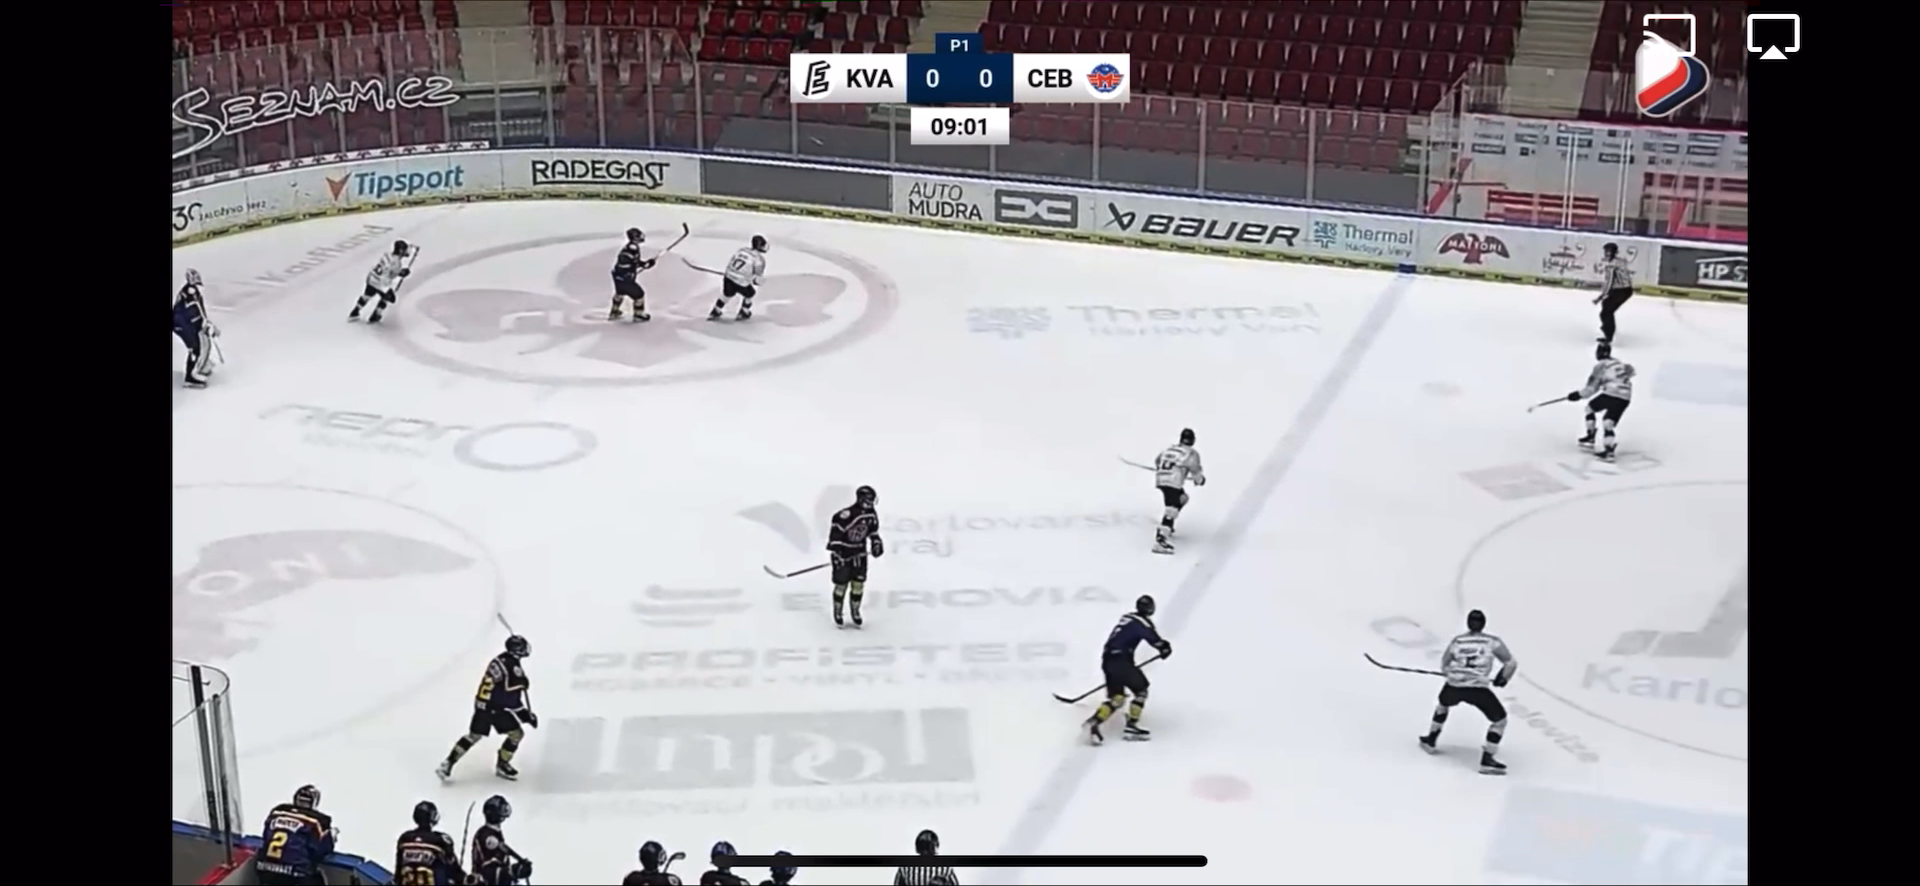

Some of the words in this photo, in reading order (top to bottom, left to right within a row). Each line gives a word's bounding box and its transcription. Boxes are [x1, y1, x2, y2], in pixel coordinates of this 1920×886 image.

[355, 165, 464, 198] Tipsport
[532, 159, 670, 189] RADEGAST
[909, 182, 963, 201] AUTO
[909, 199, 982, 221] MUDRA
[1343, 223, 1413, 244] Thermal
[1447, 239, 1503, 252] MATTONI
[1698, 263, 1729, 280] HP
[880, 510, 1163, 533] arlovarsk
[267, 831, 288, 859] 2
